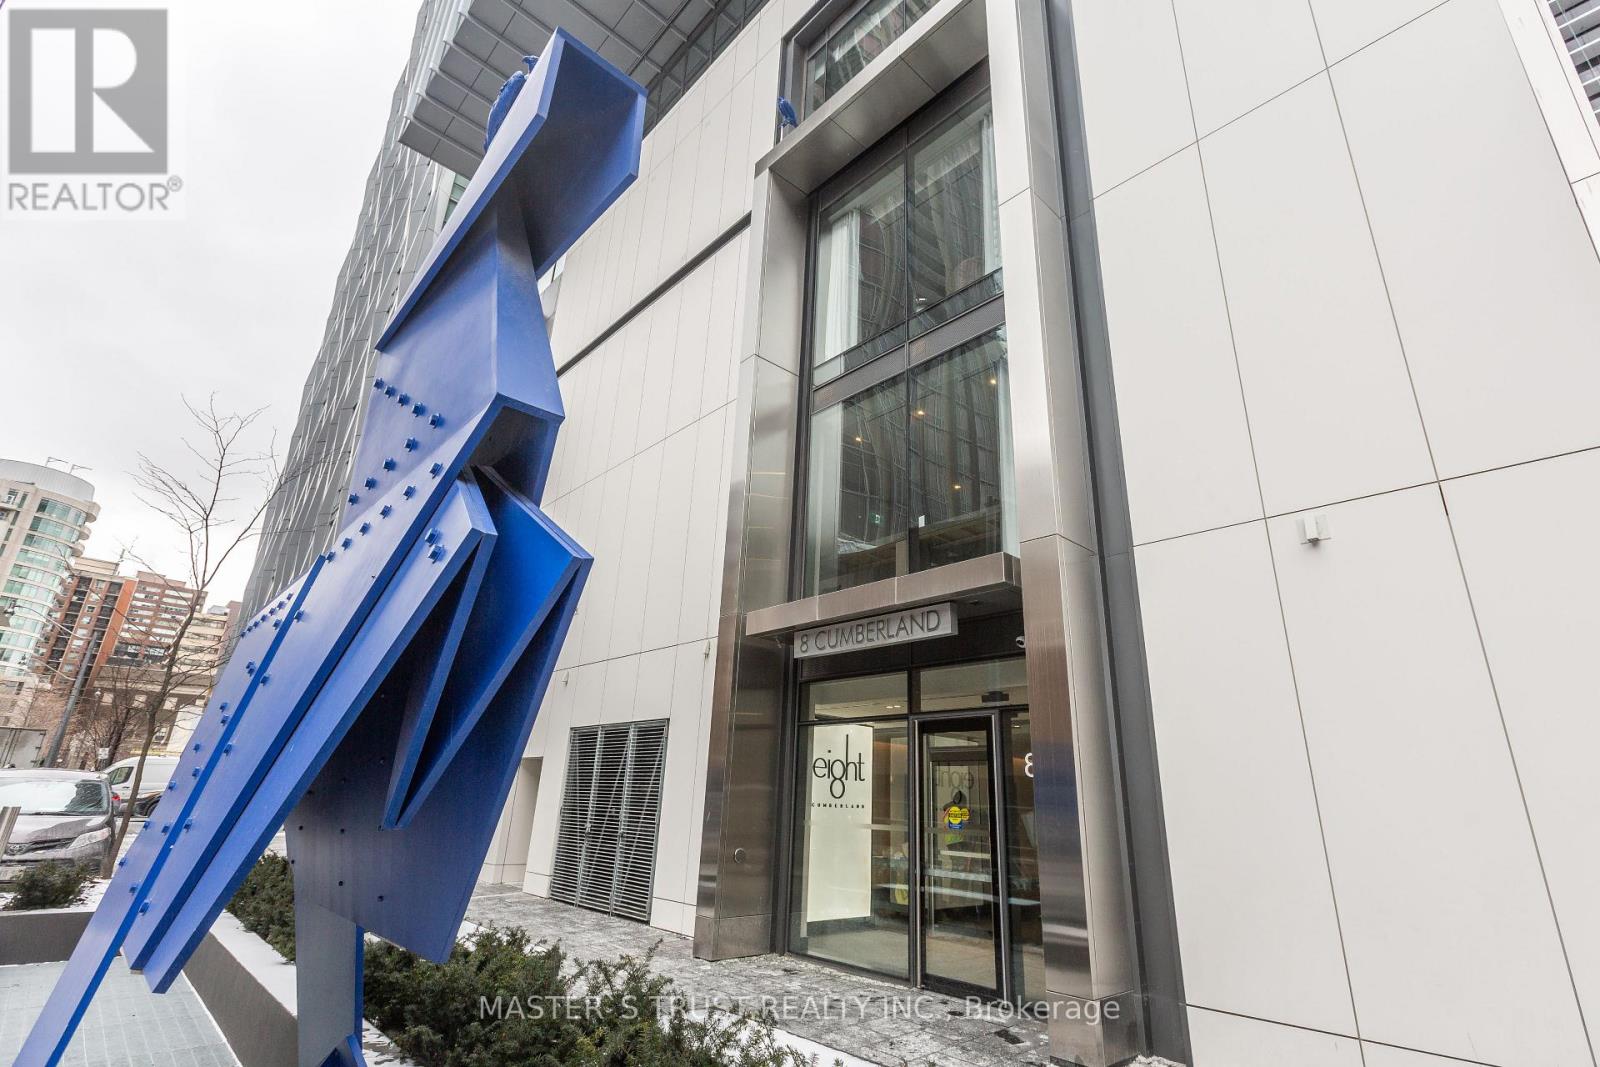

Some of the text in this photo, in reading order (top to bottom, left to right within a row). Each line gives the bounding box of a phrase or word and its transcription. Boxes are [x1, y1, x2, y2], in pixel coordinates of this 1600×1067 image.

[799, 609, 941, 654] 8 CUMBERLAND
[812, 733, 866, 799] eight
